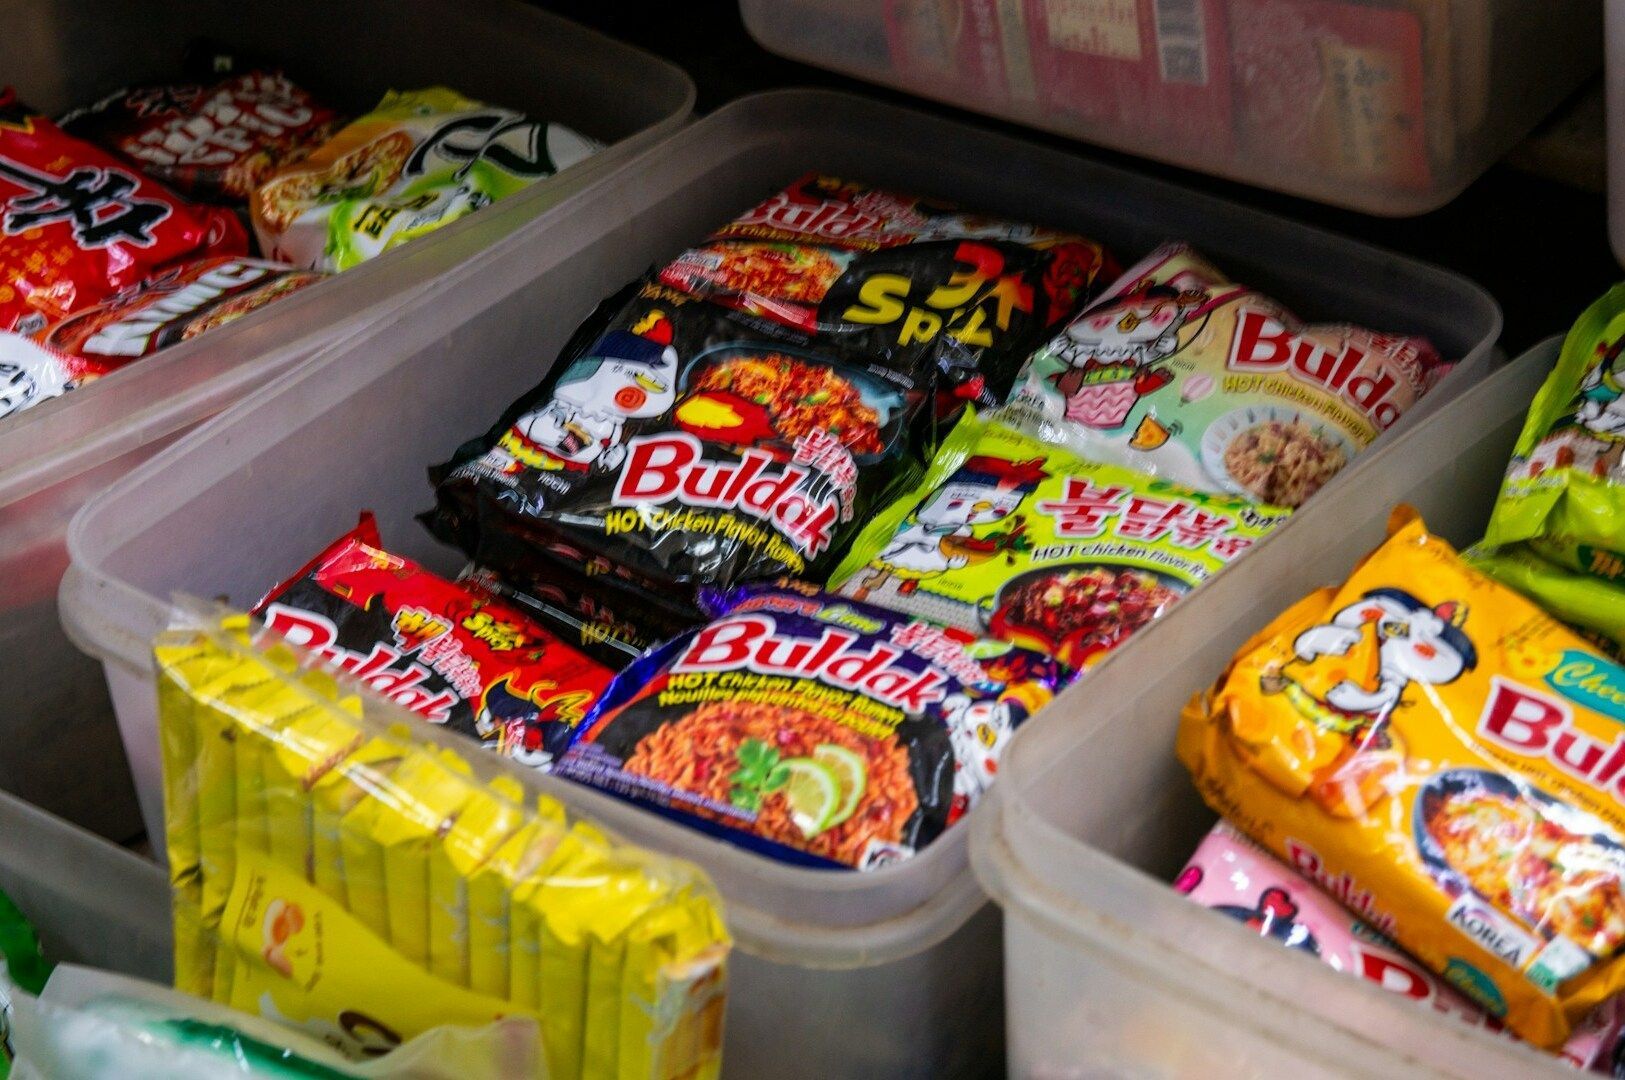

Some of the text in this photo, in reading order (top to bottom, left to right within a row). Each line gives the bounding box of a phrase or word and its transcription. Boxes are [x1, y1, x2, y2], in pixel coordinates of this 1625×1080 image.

[612, 433, 840, 562] Buldak
[714, 512, 769, 549] Flavor
[1030, 544, 1081, 565] HOT
[1080, 541, 1148, 560] Chicken
[667, 671, 718, 691] HOT
[717, 672, 795, 695] Chicken
[671, 612, 948, 714] Buldak
[1449, 903, 1524, 967] KOREA
